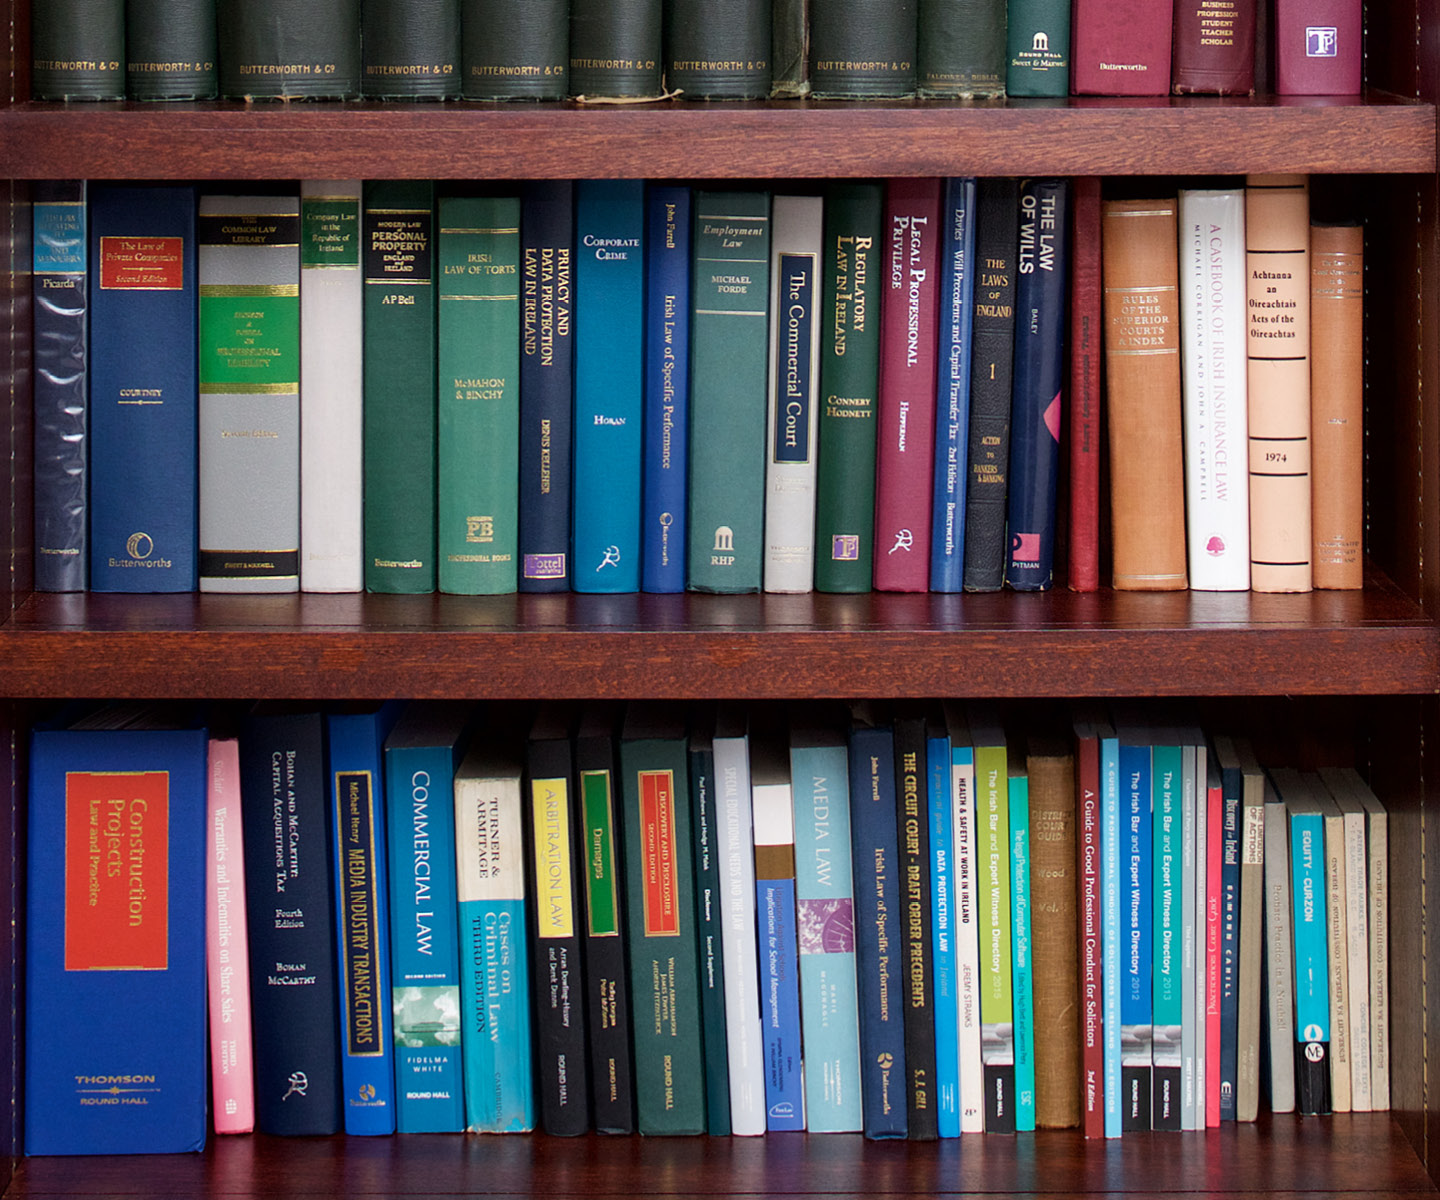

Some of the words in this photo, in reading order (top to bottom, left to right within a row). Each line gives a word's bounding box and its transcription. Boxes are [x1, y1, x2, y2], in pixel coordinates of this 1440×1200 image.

[1201, 19, 1234, 27] STUDENT
[1200, 38, 1234, 46] SCHOLAR
[239, 64, 311, 74] BUTTERWORTH
[314, 64, 323, 74] &
[673, 61, 744, 71] BUTTERWORTH
[746, 61, 755, 71] &
[1099, 62, 1148, 71] Butterworths
[1021, 195, 1036, 219] OF
[1041, 195, 1055, 229] THE
[372, 232, 427, 241] PERSONAL
[583, 234, 640, 247] CORPORATE
[703, 225, 763, 237] Employment
[910, 216, 927, 265] LEGAL
[372, 241, 427, 251] PROPERTY
[595, 249, 627, 260] CRIME
[722, 239, 743, 248] Law
[837, 236, 853, 272] LAW
[892, 216, 909, 289] PRIVILEGE
[1019, 223, 1035, 274] WILLS
[1039, 235, 1054, 271] LAW
[444, 265, 466, 274] LAW
[468, 266, 482, 274] OF
[484, 265, 515, 274] TORTS
[468, 254, 492, 262] IRISH
[525, 248, 536, 277] LAW
[542, 248, 553, 282] DATA
[986, 259, 1005, 269] THE
[43, 279, 74, 289] Picarda
[558, 248, 569, 308] PRIVACY
[712, 276, 751, 284] MICHAEL
[790, 271, 806, 300] The
[836, 275, 847, 290] IN
[853, 236, 872, 332] REGULATORY
[982, 274, 1008, 286] LAWS
[1252, 270, 1292, 280] Achtanna
[525, 280, 536, 295] IN
[718, 285, 747, 293] FORDE
[1267, 286, 1277, 294] an
[382, 296, 390, 304] A
[391, 296, 397, 304] P
[398, 296, 415, 304] Bell
[665, 295, 675, 318] Irish
[976, 305, 1011, 317] ENGLAND
[1249, 298, 1297, 309] Oireachtais
[525, 298, 536, 355] IRELAND
[541, 285, 553, 366] PROTECTION
[557, 310, 568, 336] AND
[835, 293, 852, 356] IRELAND
[907, 269, 925, 367] PROFESSIONAL
[1251, 314, 1268, 324] Acts
[1270, 314, 1280, 324] of
[1281, 314, 1294, 324] the
[664, 321, 674, 344] Law
[1251, 328, 1295, 339] Oireachtas
[664, 347, 674, 360] of
[786, 306, 805, 397] Commercial
[662, 362, 676, 402] Specific
[990, 363, 995, 380] 1
[454, 379, 505, 388] McMAHON
[456, 391, 463, 399] &
[466, 390, 503, 400] BINCHY
[828, 395, 871, 406] CONNERY
[827, 407, 872, 418] HODNETT
[785, 402, 802, 448] Court
[662, 405, 674, 469] Performance
[1265, 452, 1287, 462] 1974
[109, 558, 172, 568] Butterworths
[711, 556, 735, 565] RHP
[1131, 772, 1140, 790] The
[90, 800, 101, 825] Law
[813, 777, 830, 840] MEDIA
[1131, 793, 1140, 813] Irish
[489, 797, 500, 862] TURNER
[1131, 816, 1140, 834] Bar
[90, 828, 101, 853] and
[104, 800, 125, 877] Projects
[412, 771, 431, 905] COMMERCIAL
[477, 799, 488, 879] ARMITAGE
[545, 789, 562, 890] ARBITRATION
[1131, 835, 1139, 853] and
[1303, 830, 1312, 869] EQUITY
[129, 799, 148, 926] Construction
[349, 849, 365, 887] MEDIA
[492, 866, 500, 878] &
[815, 848, 832, 886] LAW
[1130, 855, 1140, 887] Expert
[89, 856, 101, 906] Practice
[1131, 889, 1141, 928] Witness
[1304, 877, 1313, 922] CURZON
[350, 891, 369, 949] INDUSTRY
[550, 896, 564, 927] LAW
[415, 912, 433, 956] LAW
[1129, 931, 1141, 975] Directory
[353, 953, 373, 1044] TRANSACTIONS
[1131, 977, 1140, 1001] 2012
[75, 1075, 155, 1084] THOMSON
